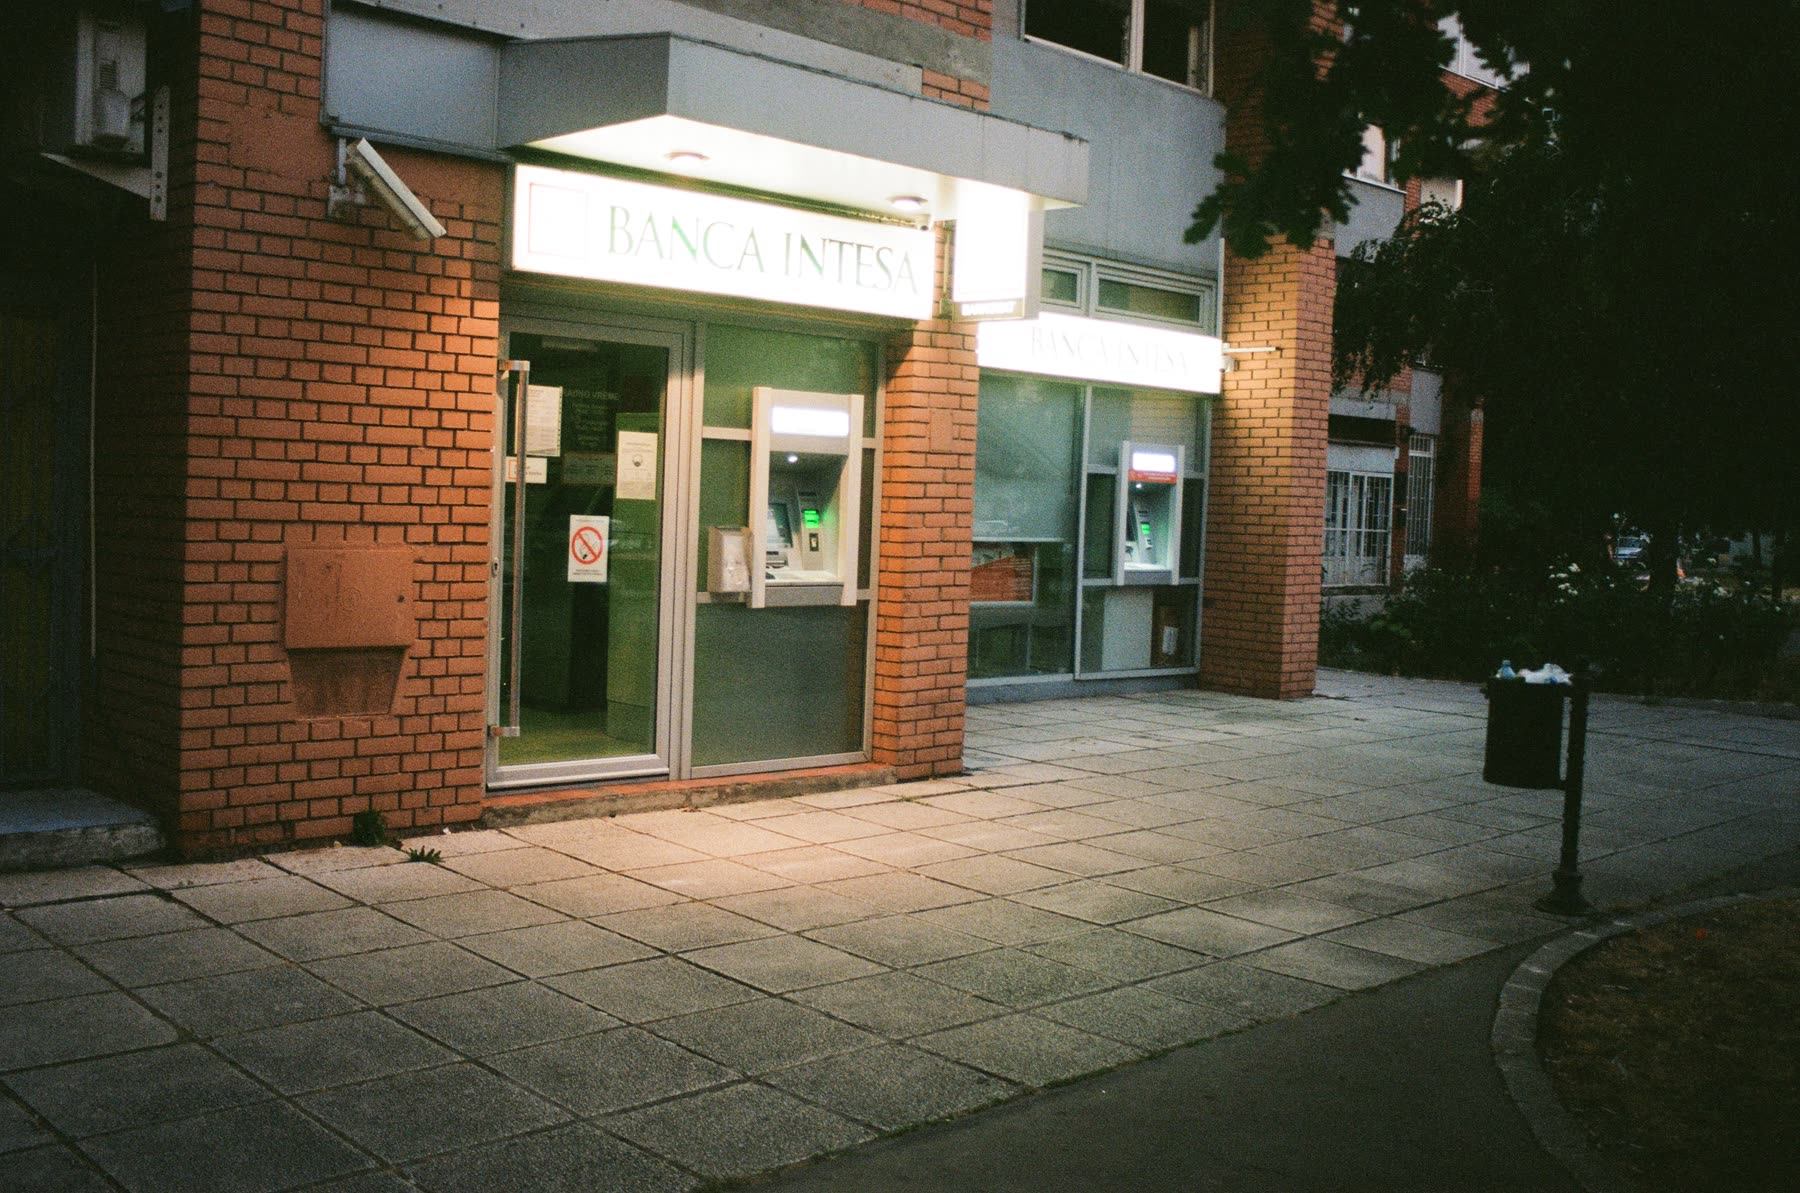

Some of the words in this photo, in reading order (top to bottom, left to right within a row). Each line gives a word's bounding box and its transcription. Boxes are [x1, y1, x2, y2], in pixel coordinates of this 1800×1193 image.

[608, 205, 766, 274] BANCA
[783, 231, 920, 295] INTESA
[1031, 326, 1109, 367] BANCA
